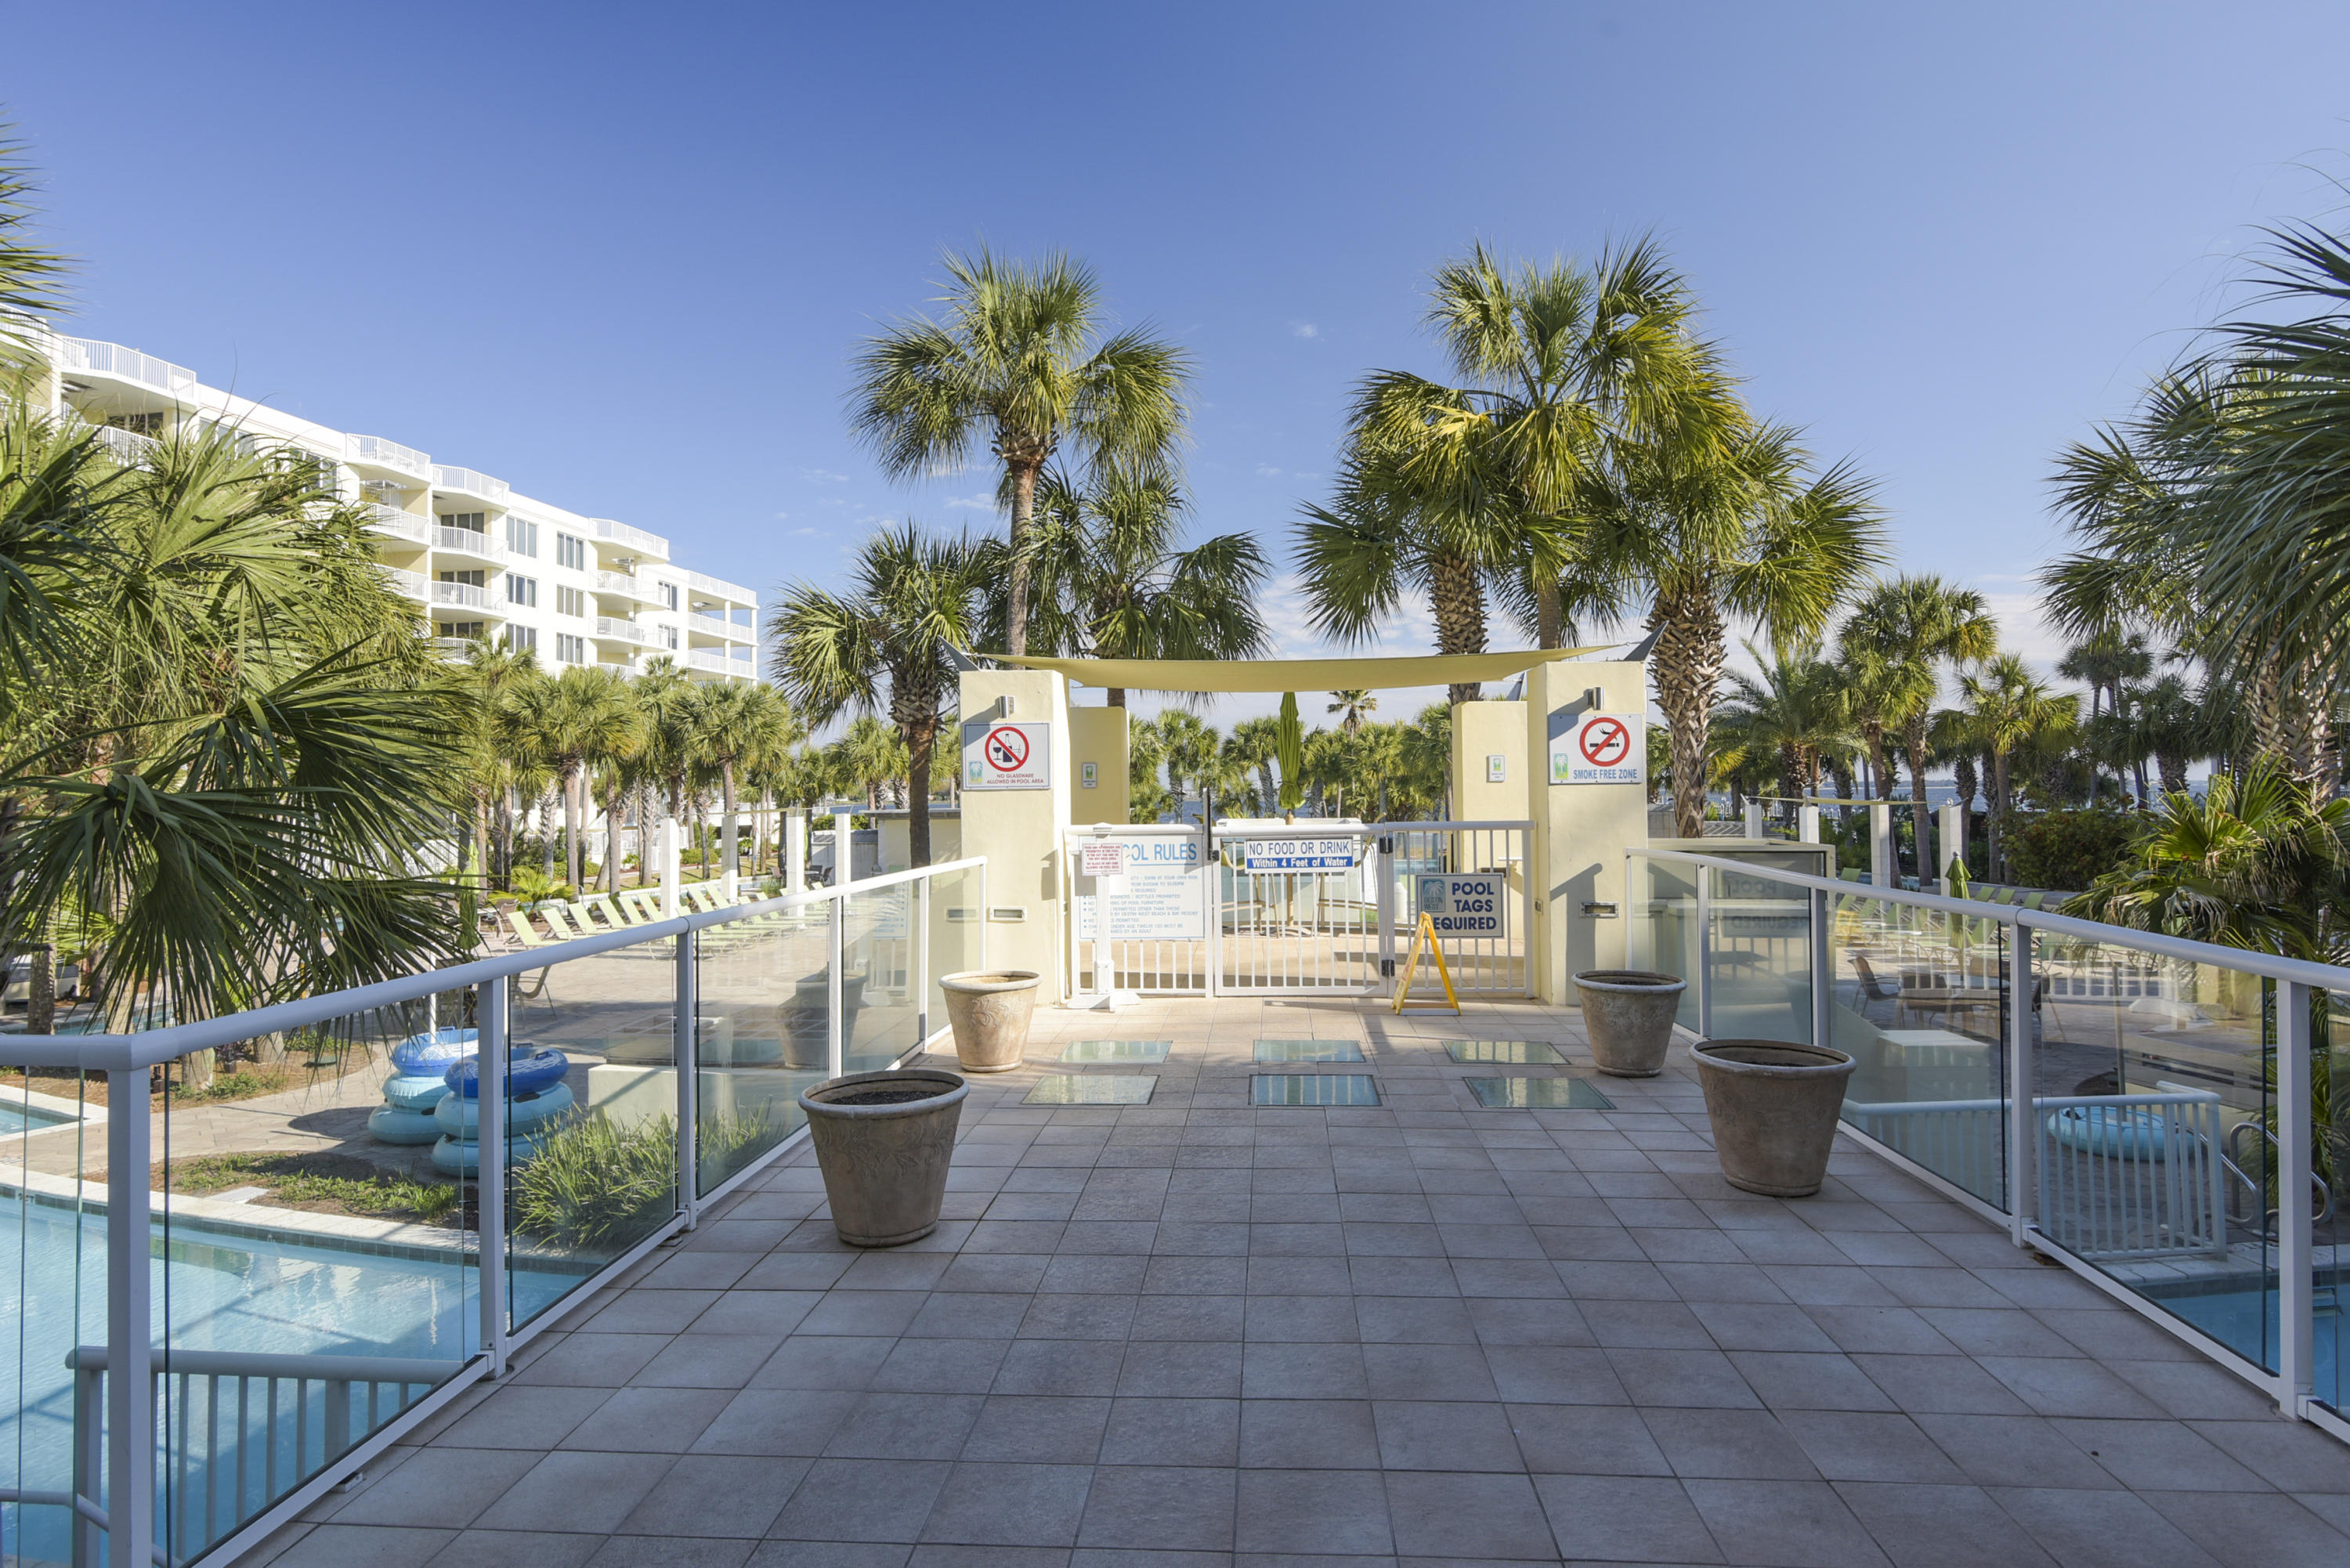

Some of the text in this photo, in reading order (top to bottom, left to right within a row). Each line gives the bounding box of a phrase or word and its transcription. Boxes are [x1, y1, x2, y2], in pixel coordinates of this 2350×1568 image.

[1573, 768, 1637, 779] SMOKE FREE ZONE
[1154, 843, 1197, 861] RULES
[1249, 841, 1350, 855] NO FOOD OR DRINK
[1252, 857, 1347, 868] Within 4 Feet of Water
[1452, 882, 1495, 895] POOL
[1454, 899, 1493, 912] TAGS
[1433, 916, 1497, 930] EQUIRED
